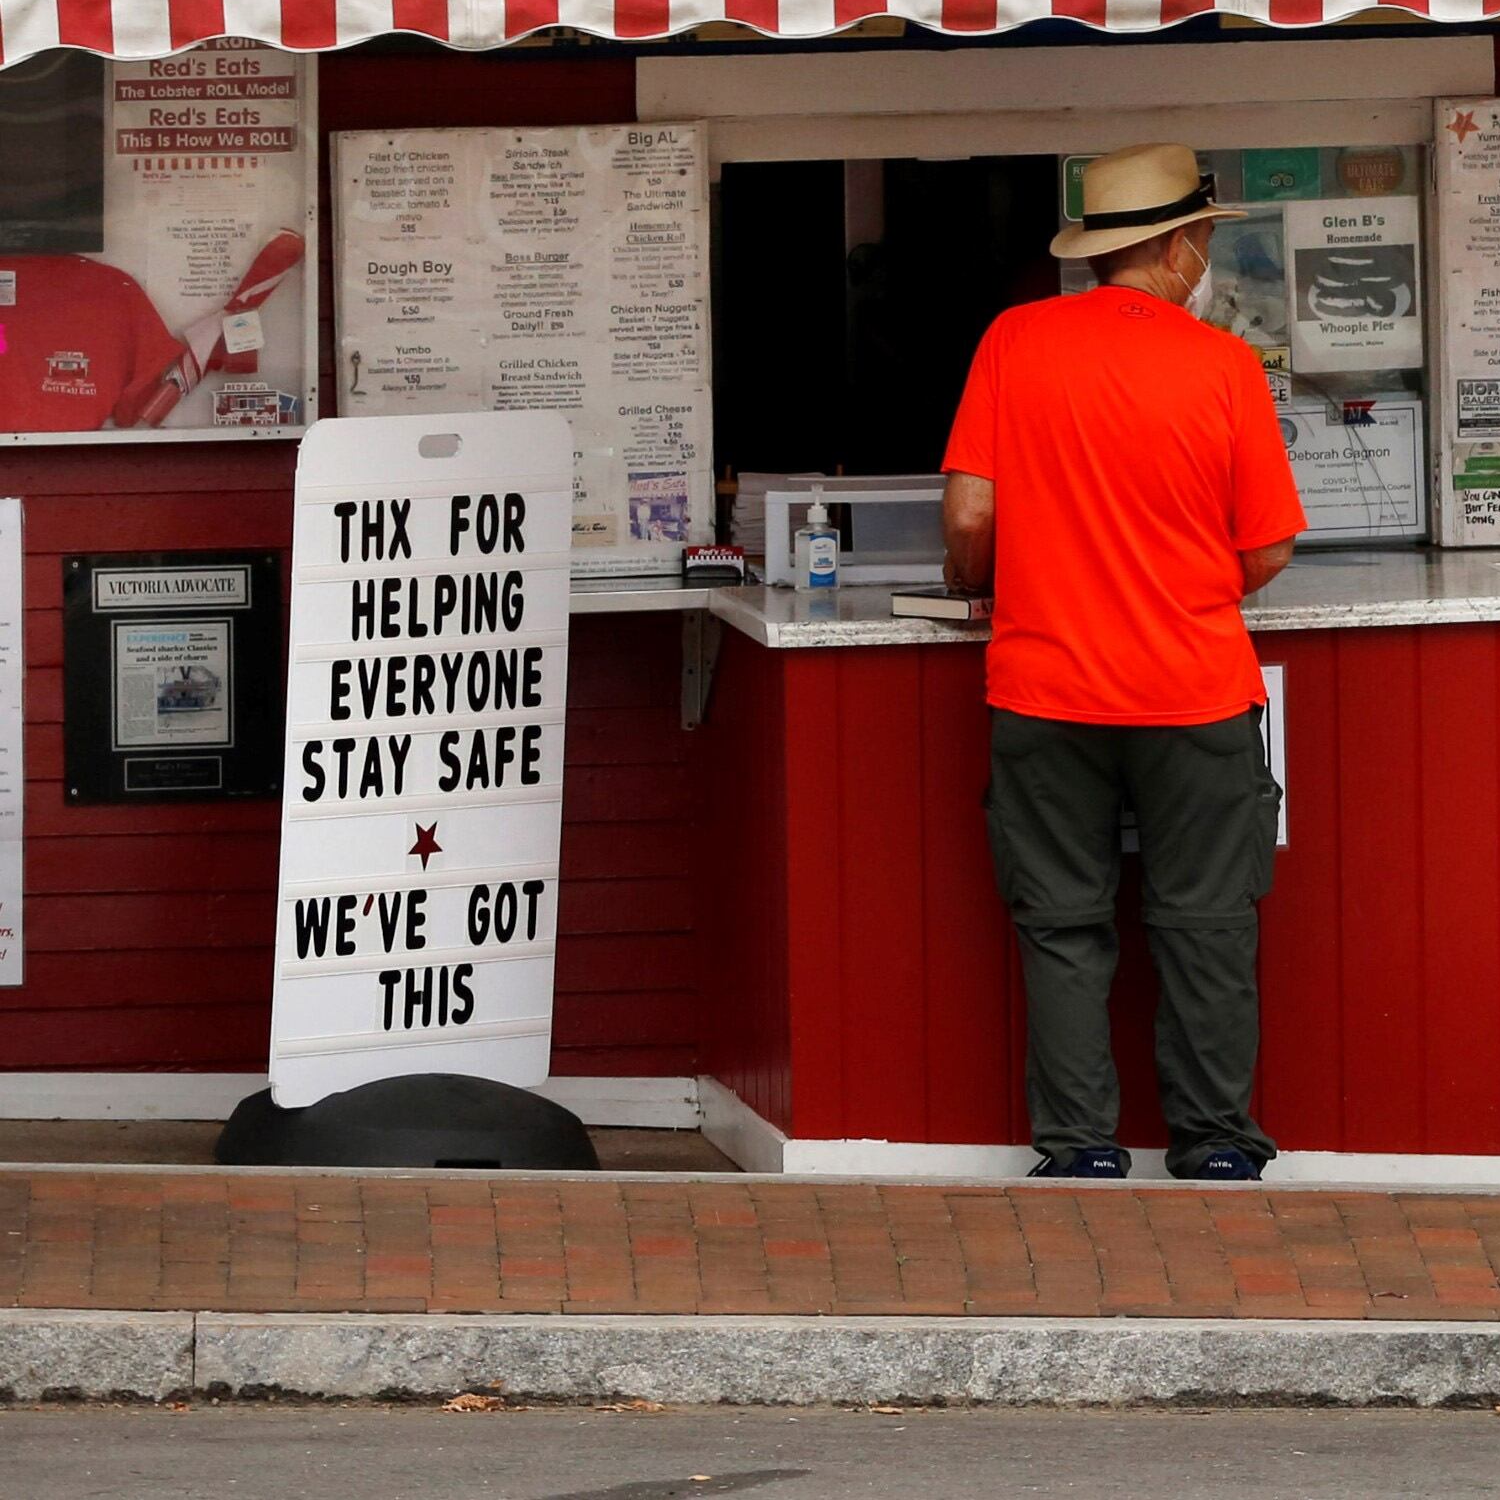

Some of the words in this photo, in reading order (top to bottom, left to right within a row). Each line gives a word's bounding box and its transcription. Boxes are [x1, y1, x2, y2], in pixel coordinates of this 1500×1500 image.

[150, 59, 206, 76] Red's
[216, 58, 260, 74] Eats
[121, 87, 145, 98] The
[150, 85, 201, 97] Lobster
[207, 84, 241, 95] ROLL
[247, 83, 289, 94] Model
[150, 108, 206, 126] Red's
[216, 108, 260, 124] Eats
[121, 134, 151, 148] This
[158, 134, 170, 146] Is
[177, 134, 212, 146] How
[218, 133, 244, 146] We
[250, 132, 287, 145] ROLL
[628, 133, 653, 146] Big
[1323, 217, 1356, 227] Glen
[1362, 215, 1385, 226] B's
[1327, 233, 1382, 243] Homemade
[368, 262, 417, 276] Dough
[423, 261, 452, 275] Boy
[1320, 322, 1368, 334] Whoopie
[1373, 321, 1394, 331] Pies
[1288, 449, 1338, 461] Deborah
[1343, 448, 1390, 460] Gagnon
[1465, 503, 1483, 514] BUT
[334, 498, 411, 562] THX
[450, 492, 525, 556] FOR
[109, 580, 170, 596] VICTORIA
[173, 578, 235, 593] ADVOCATE
[351, 569, 524, 641] HELPING
[330, 647, 542, 721] EVERYONE
[302, 734, 411, 802] STAY
[439, 725, 541, 792] SAFE
[295, 888, 427, 958] WE'VE
[468, 880, 544, 946] GOT
[379, 964, 474, 1030] THIS
